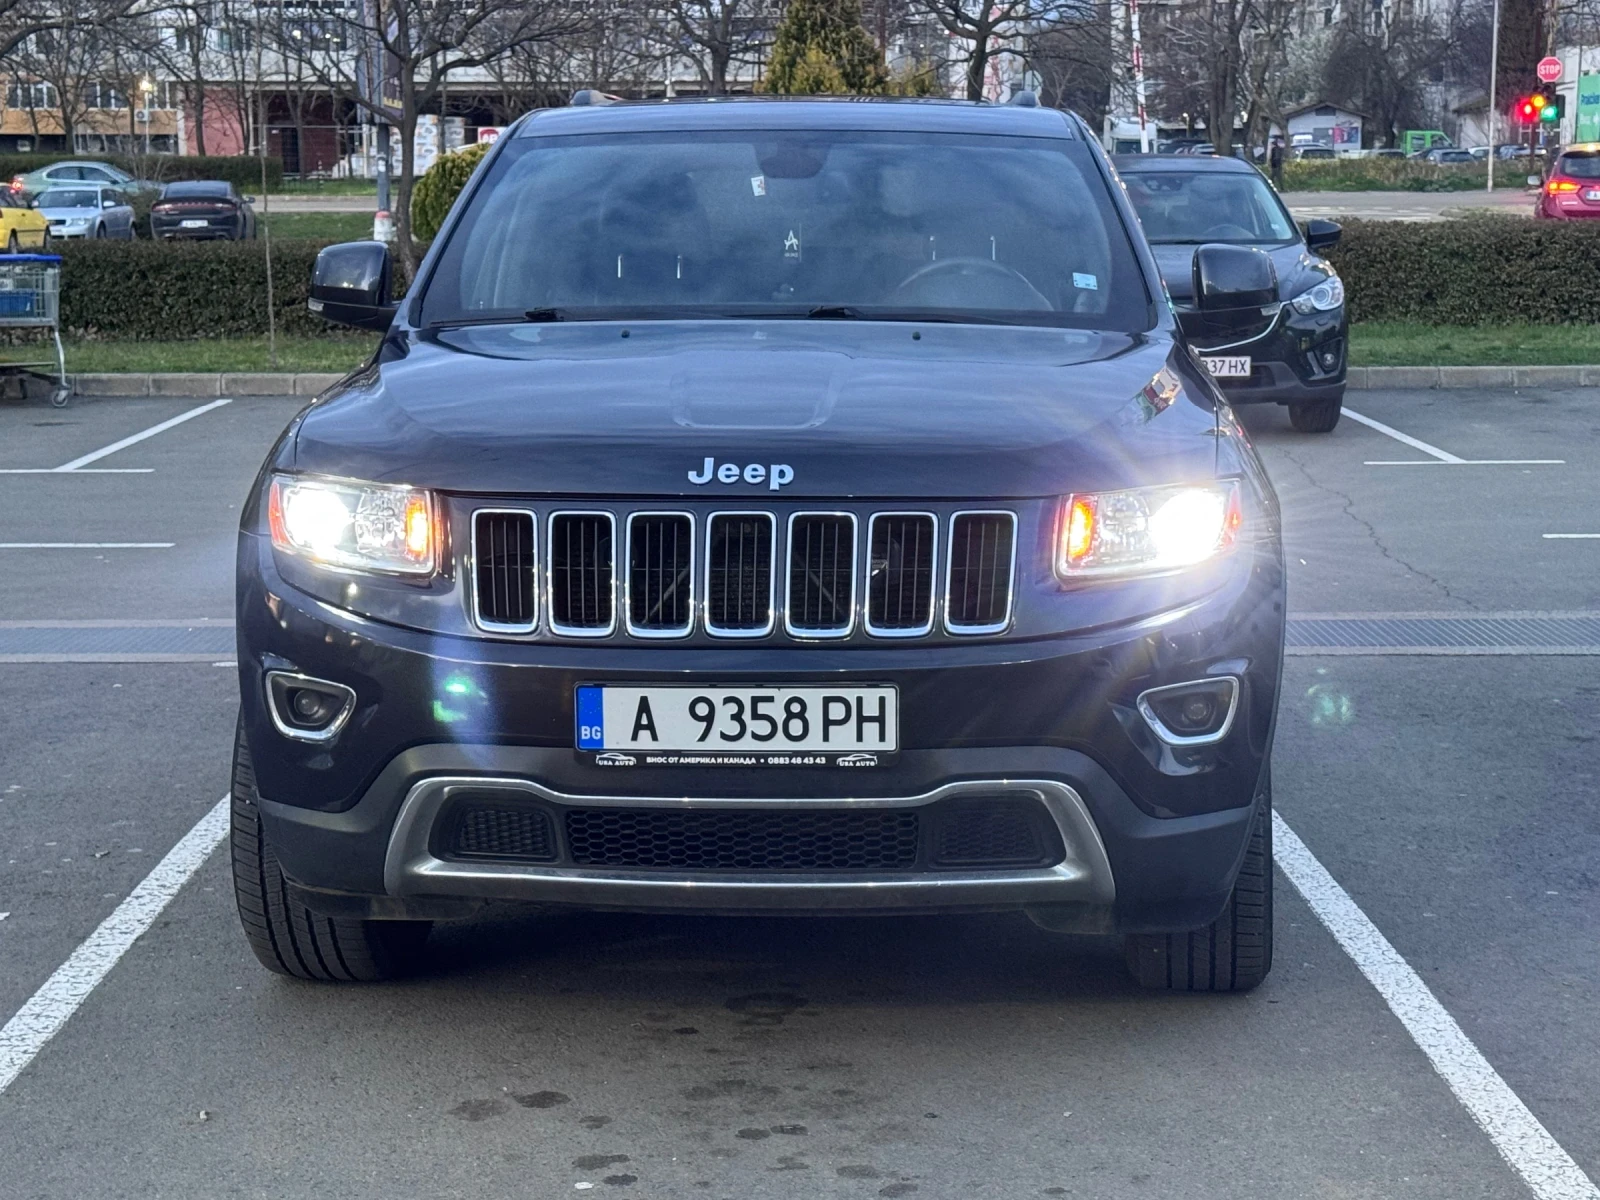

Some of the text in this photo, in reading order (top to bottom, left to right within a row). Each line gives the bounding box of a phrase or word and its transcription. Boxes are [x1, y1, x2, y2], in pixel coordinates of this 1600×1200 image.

[1540, 64, 1560, 75] STOP
[1228, 359, 1247, 374] HX
[687, 457, 794, 491] Jeep
[630, 695, 660, 743] A
[581, 725, 602, 741] BG
[614, 759, 635, 767] AUTO
[679, 756, 717, 765] АМЕРИКА
[723, 756, 757, 765] КАНАДА
[767, 756, 790, 765] 0883
[790, 756, 803, 765] 48
[803, 756, 815, 765] 43
[815, 756, 827, 765] 43
[855, 760, 876, 768] AUTO
